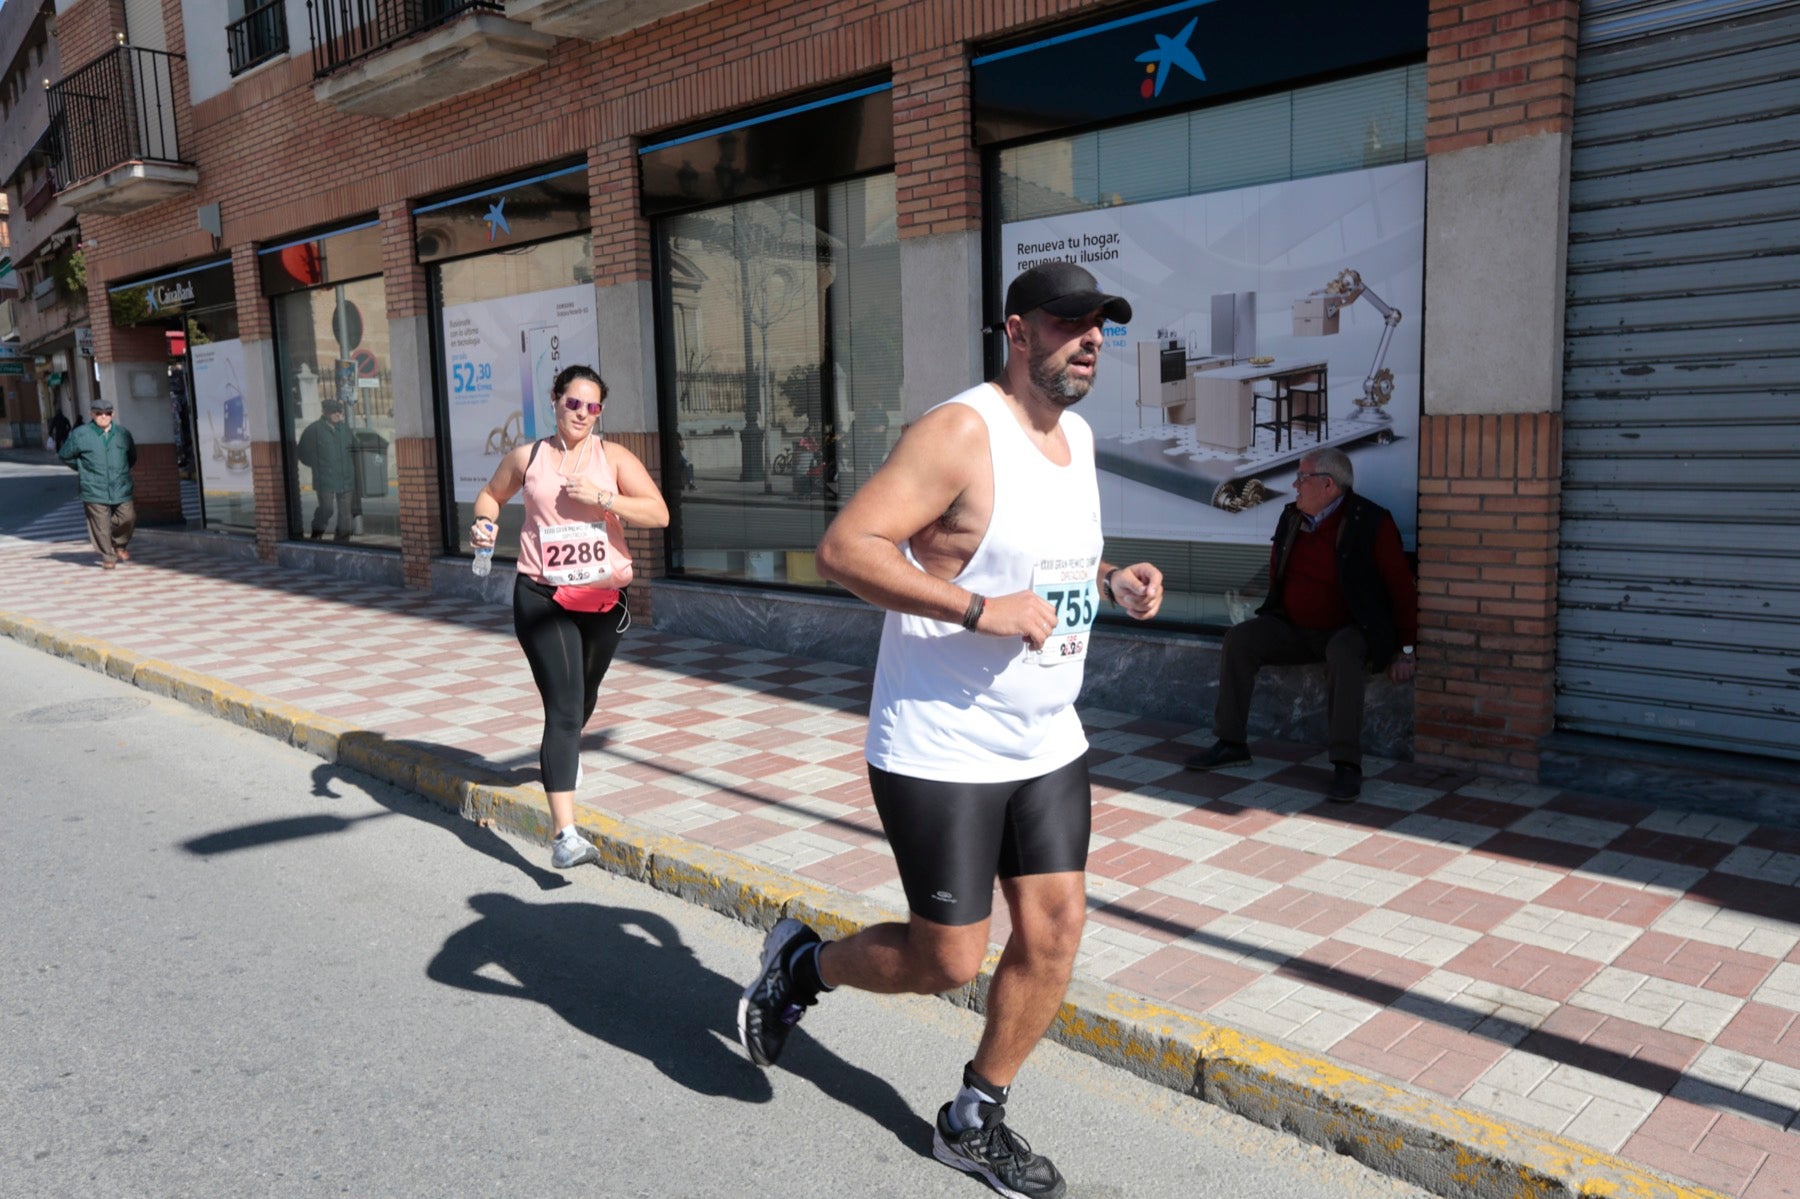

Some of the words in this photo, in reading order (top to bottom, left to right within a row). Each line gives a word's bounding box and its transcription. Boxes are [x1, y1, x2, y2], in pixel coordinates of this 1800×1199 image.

[1017, 240, 1065, 255] Renueva
[1068, 238, 1080, 249] tu
[1083, 233, 1120, 248] hogar,
[1065, 254, 1077, 264] tu
[1080, 247, 1119, 263] ilusión
[158, 280, 195, 304] CaixaBank
[551, 335, 560, 361] 5G
[546, 540, 606, 567] 2286
